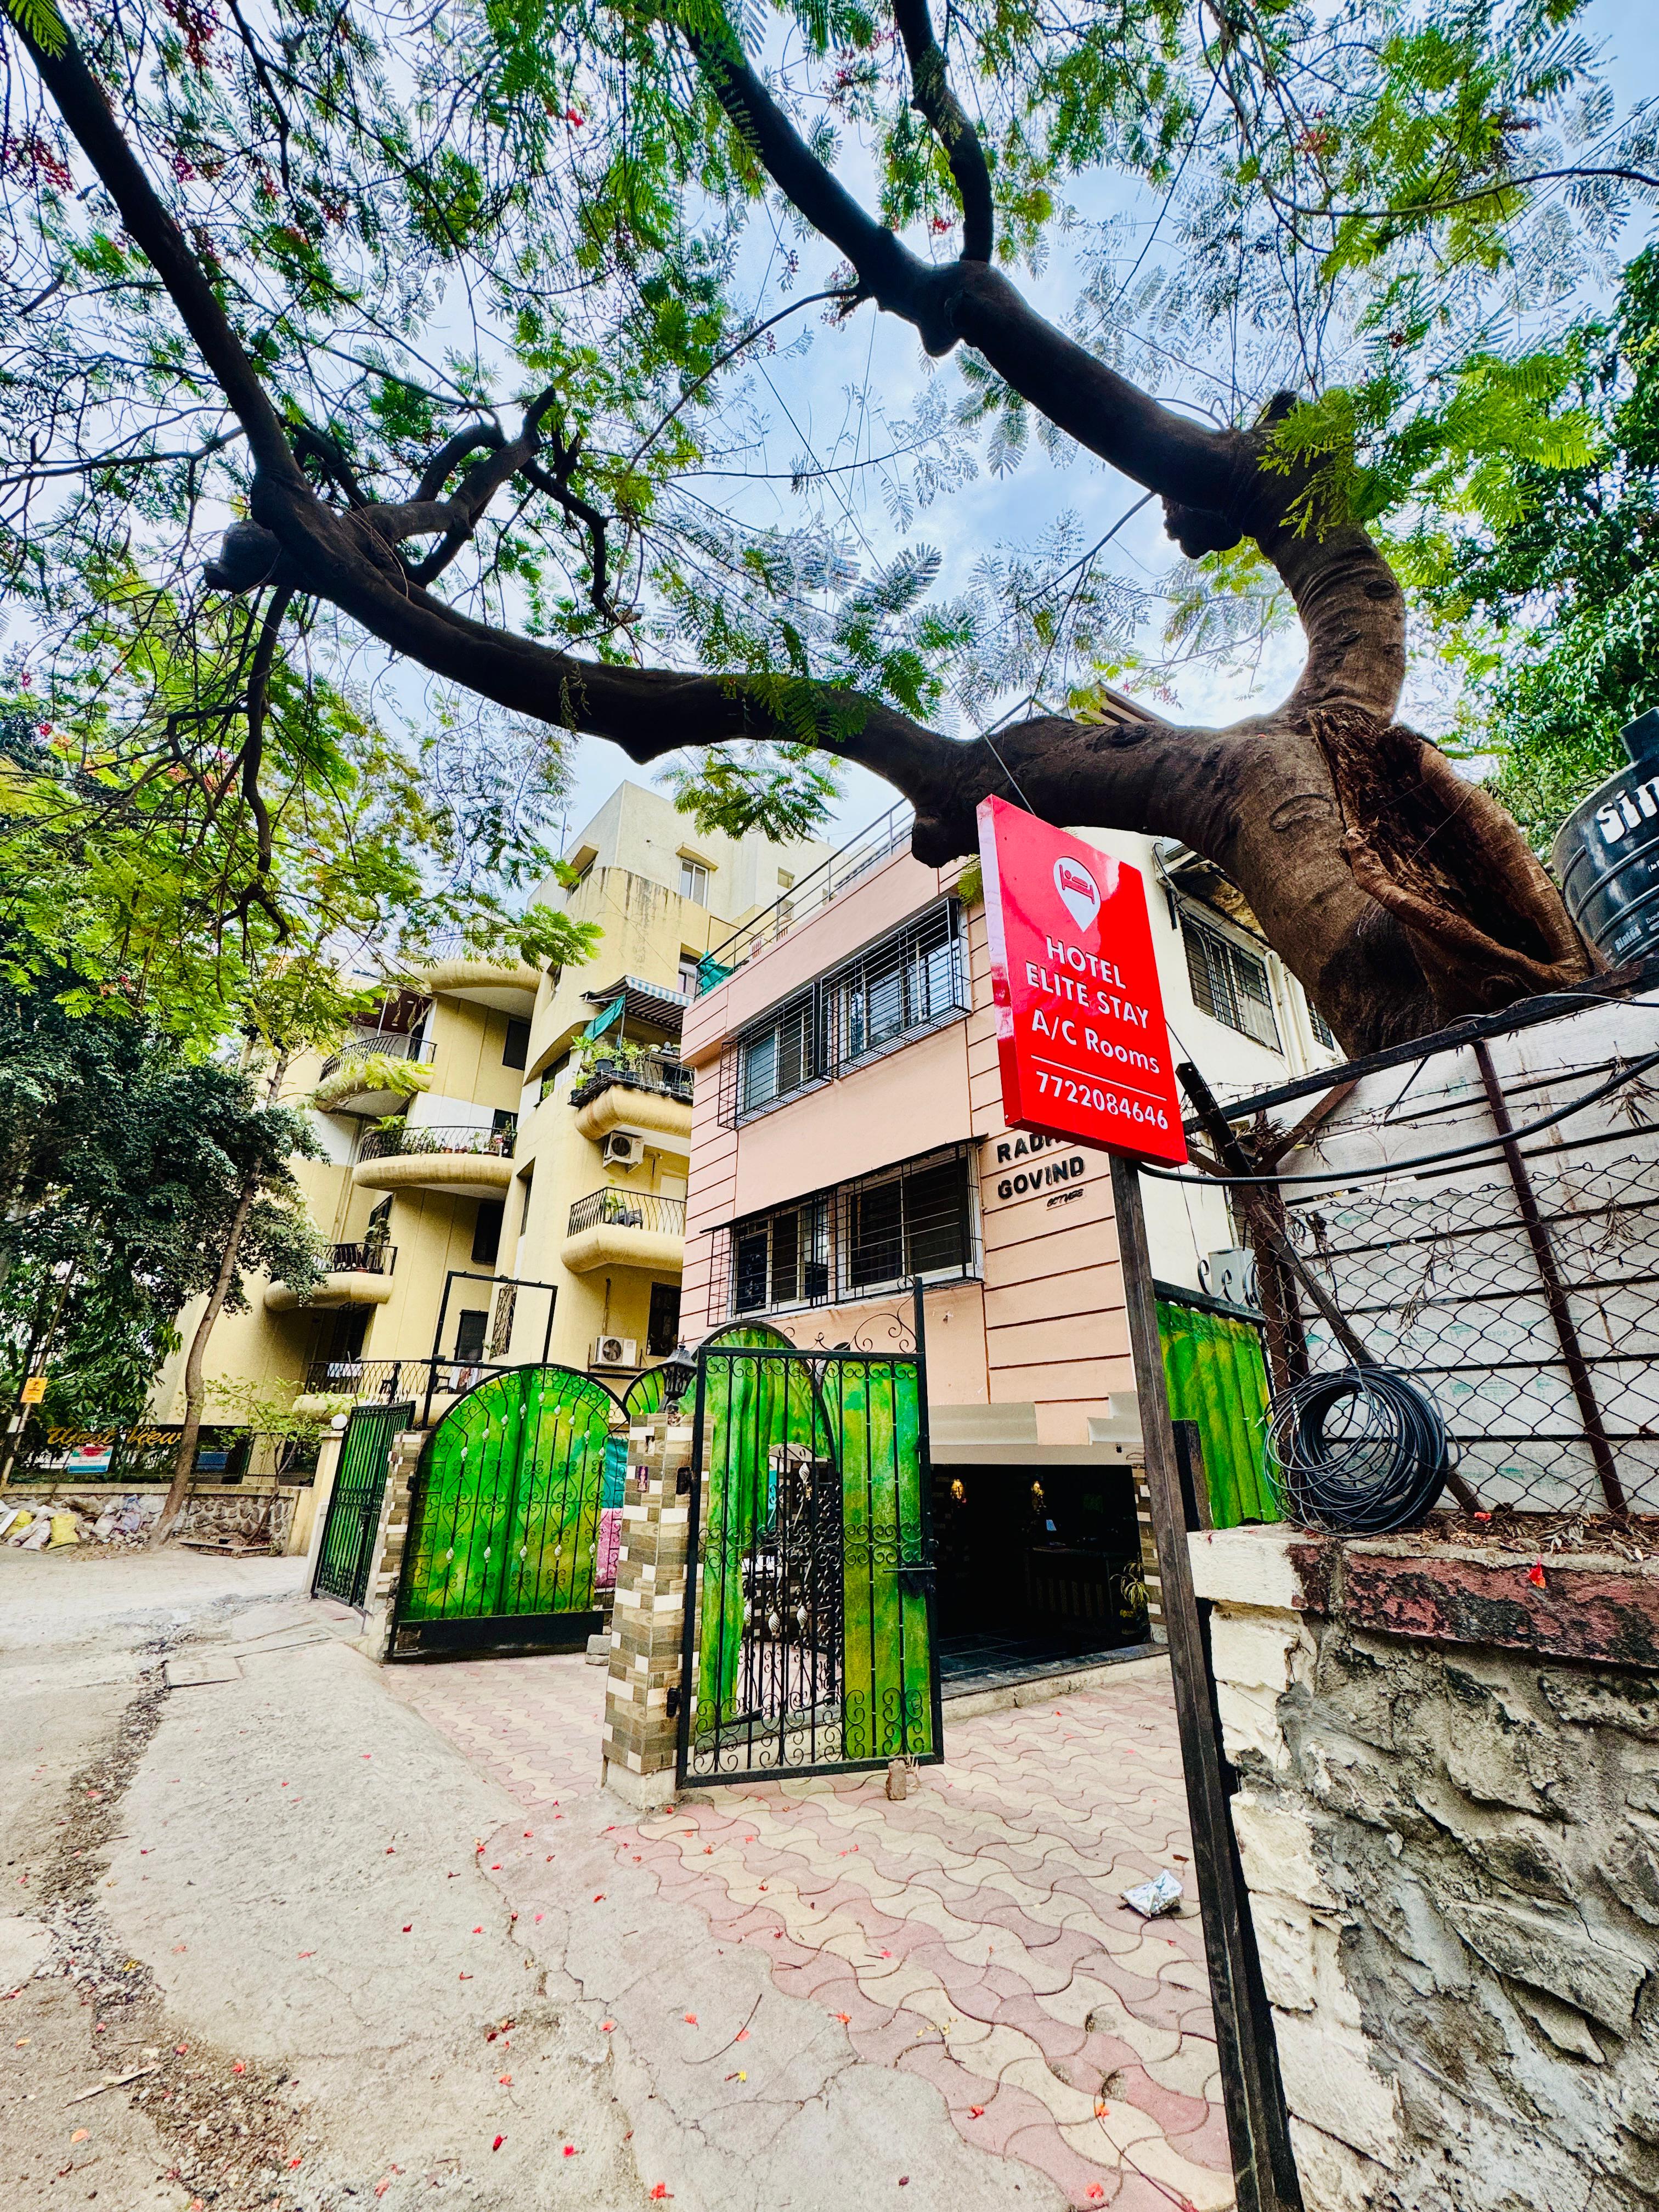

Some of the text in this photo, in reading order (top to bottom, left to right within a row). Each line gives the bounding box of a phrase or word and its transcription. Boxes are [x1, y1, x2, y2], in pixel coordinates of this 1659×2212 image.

[1046, 935, 1126, 989] HOTEL
[1025, 961, 1149, 1029] ELITE STAY
[1032, 1008, 1160, 1074] A/C Rooms
[1036, 1070, 1169, 1130] 7722084646
[998, 1156, 1085, 1199] GOVIND
[47, 1425, 183, 1445] West View
